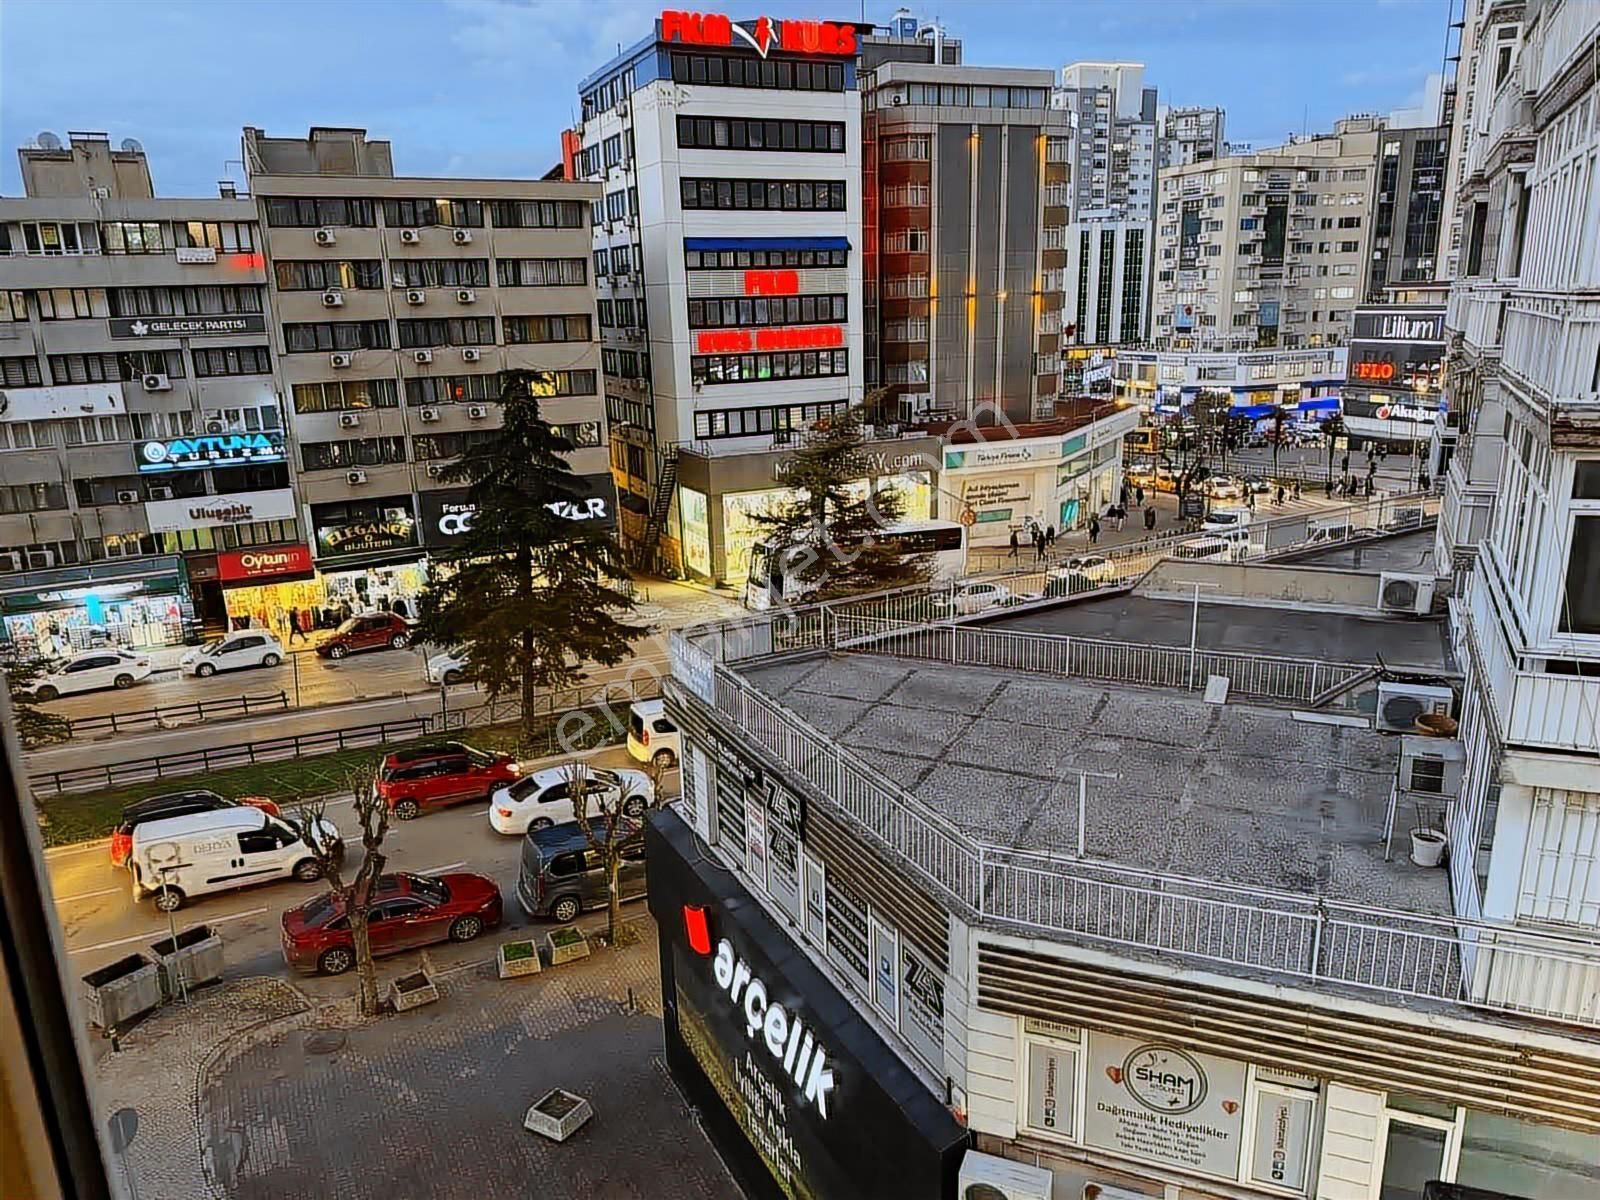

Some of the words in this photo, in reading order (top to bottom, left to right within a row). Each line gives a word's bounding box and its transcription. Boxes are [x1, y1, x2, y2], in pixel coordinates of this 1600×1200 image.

[661, 10, 732, 45] FKM
[781, 19, 858, 54] KURS
[151, 321, 204, 332] GELECEK
[1359, 363, 1393, 379] FLO
[169, 433, 273, 454] AYTUNA
[326, 522, 410, 546] ELEGANCE
[714, 937, 834, 1120] arçelik
[1136, 1067, 1194, 1107] SHAM
[1097, 1102, 1157, 1123] Dağıtmalık
[1160, 1115, 1230, 1140] Hediyelikler
